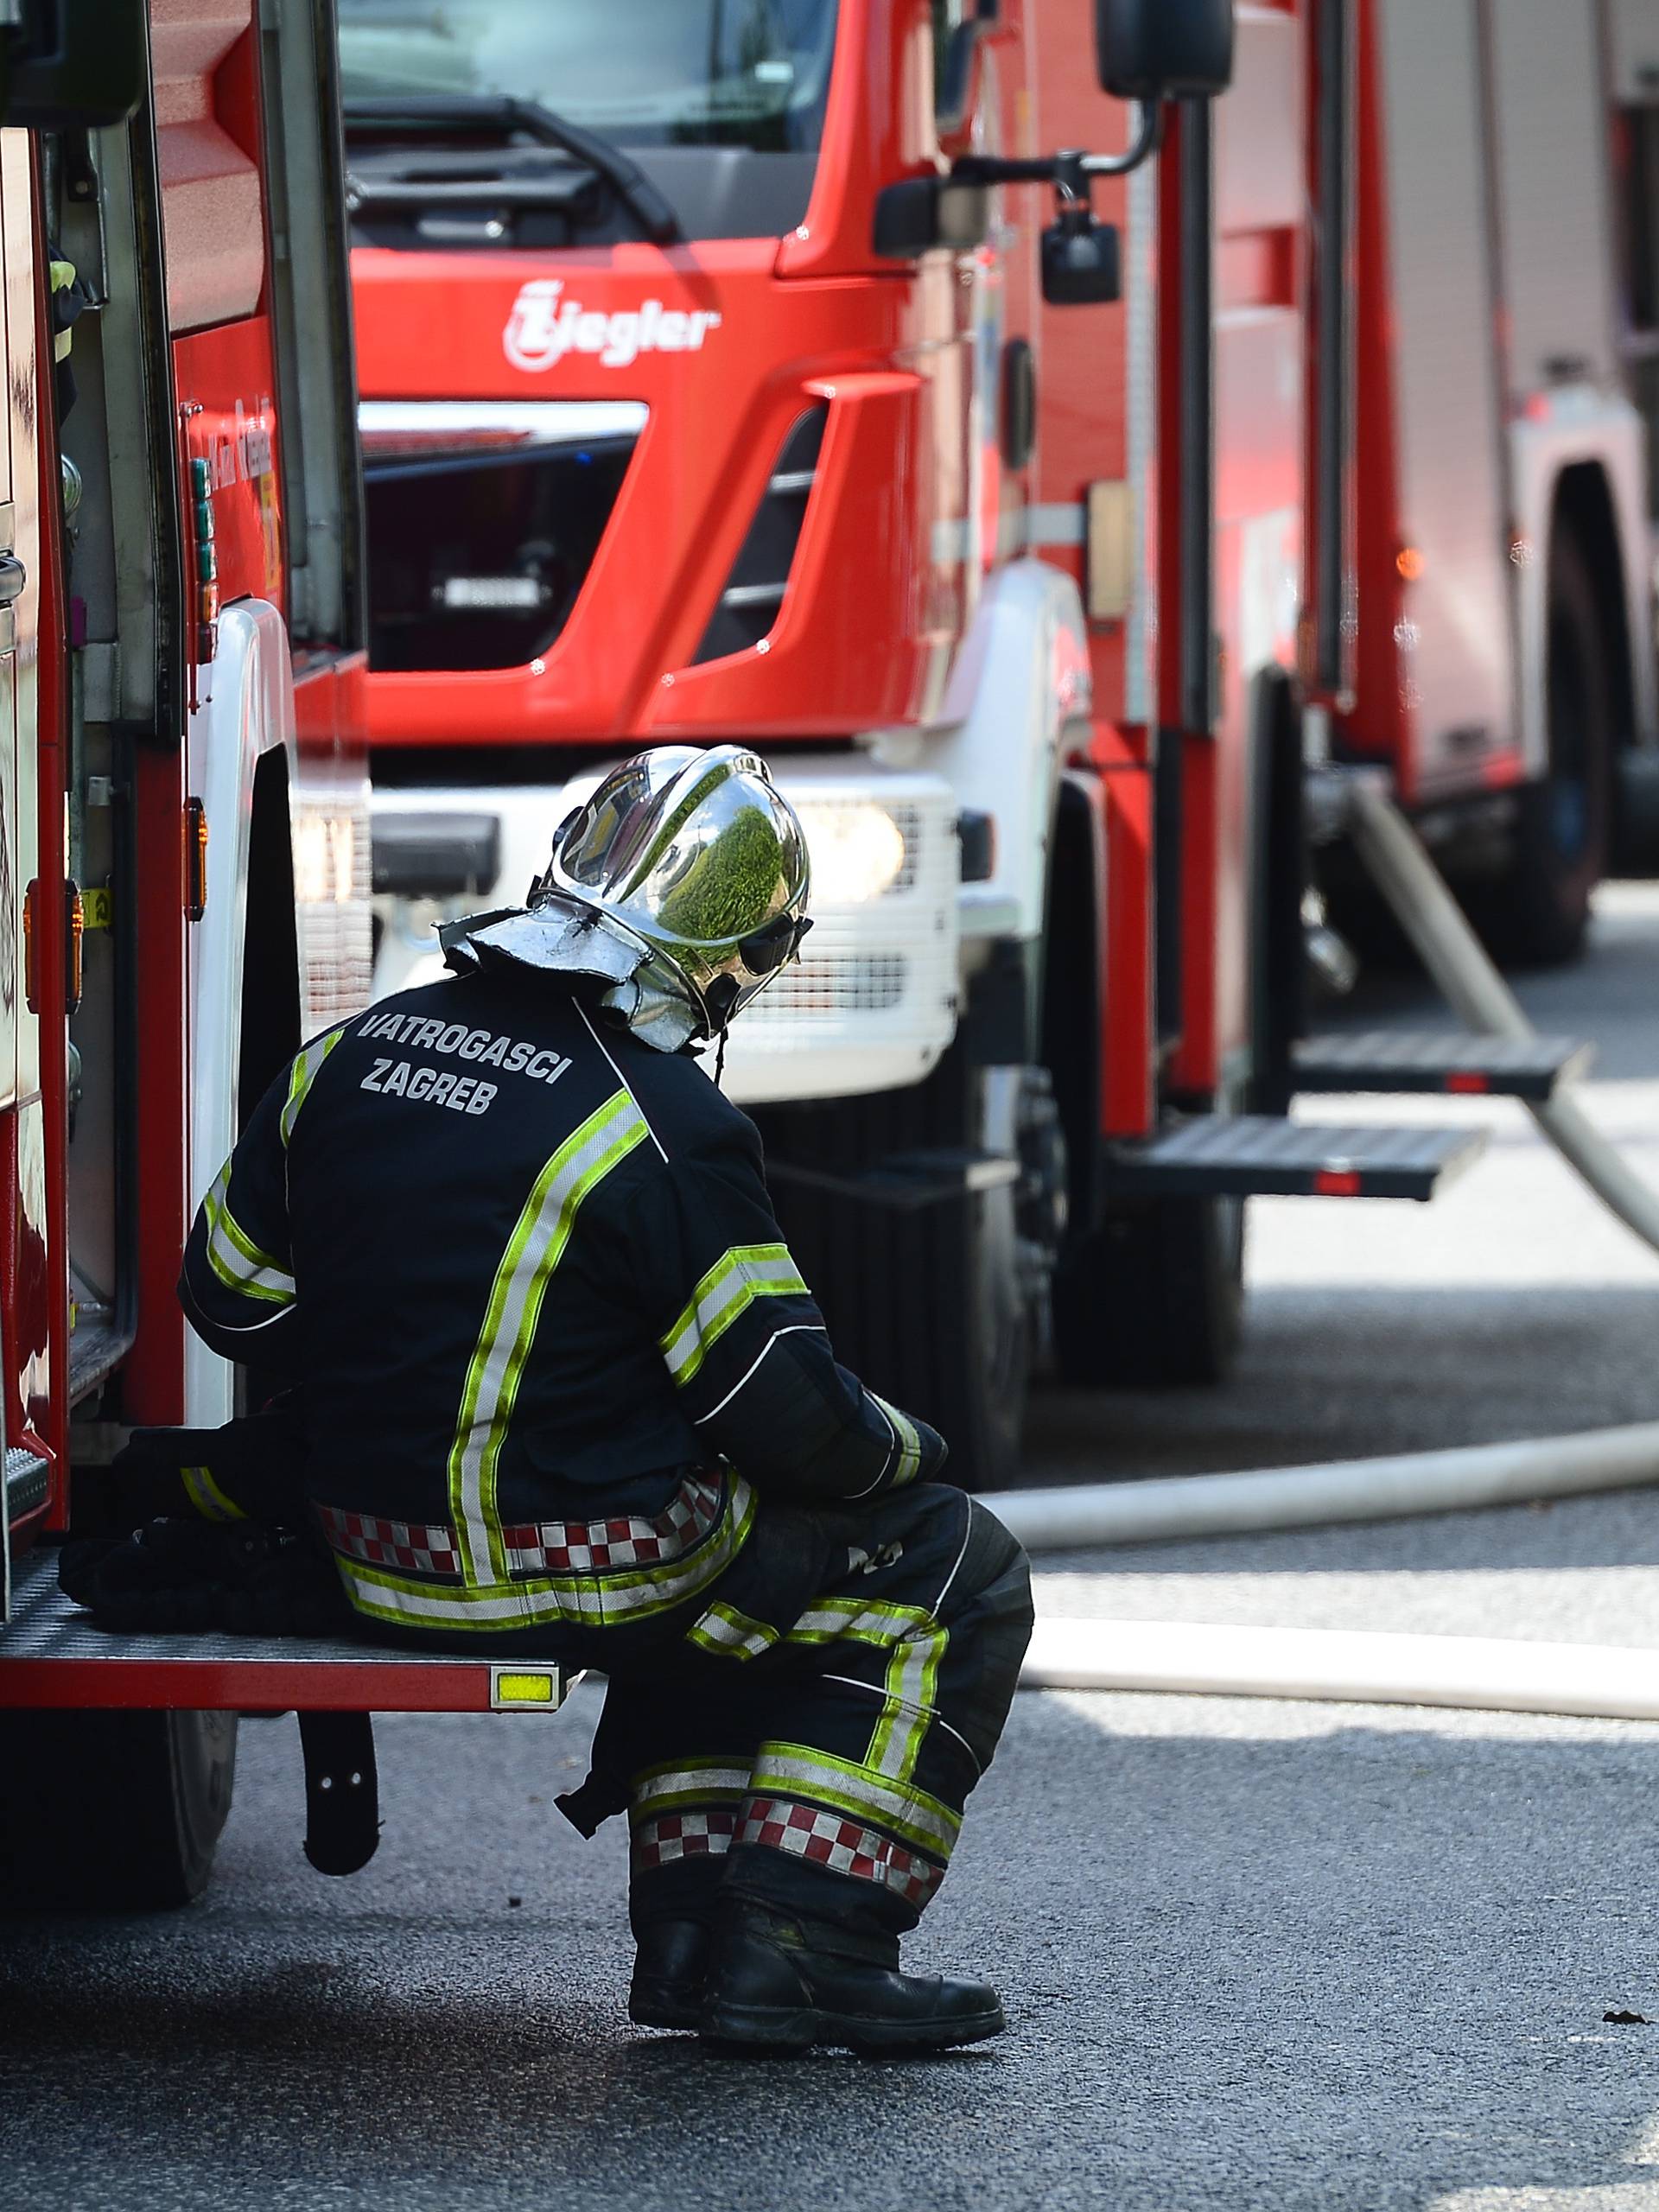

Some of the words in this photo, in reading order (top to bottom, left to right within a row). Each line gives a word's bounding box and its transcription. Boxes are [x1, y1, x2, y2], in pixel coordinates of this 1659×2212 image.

[504, 280, 720, 372] Ziegler
[357, 1013, 573, 1084] VATROGASCI
[359, 1058, 499, 1115] ZAGREB
